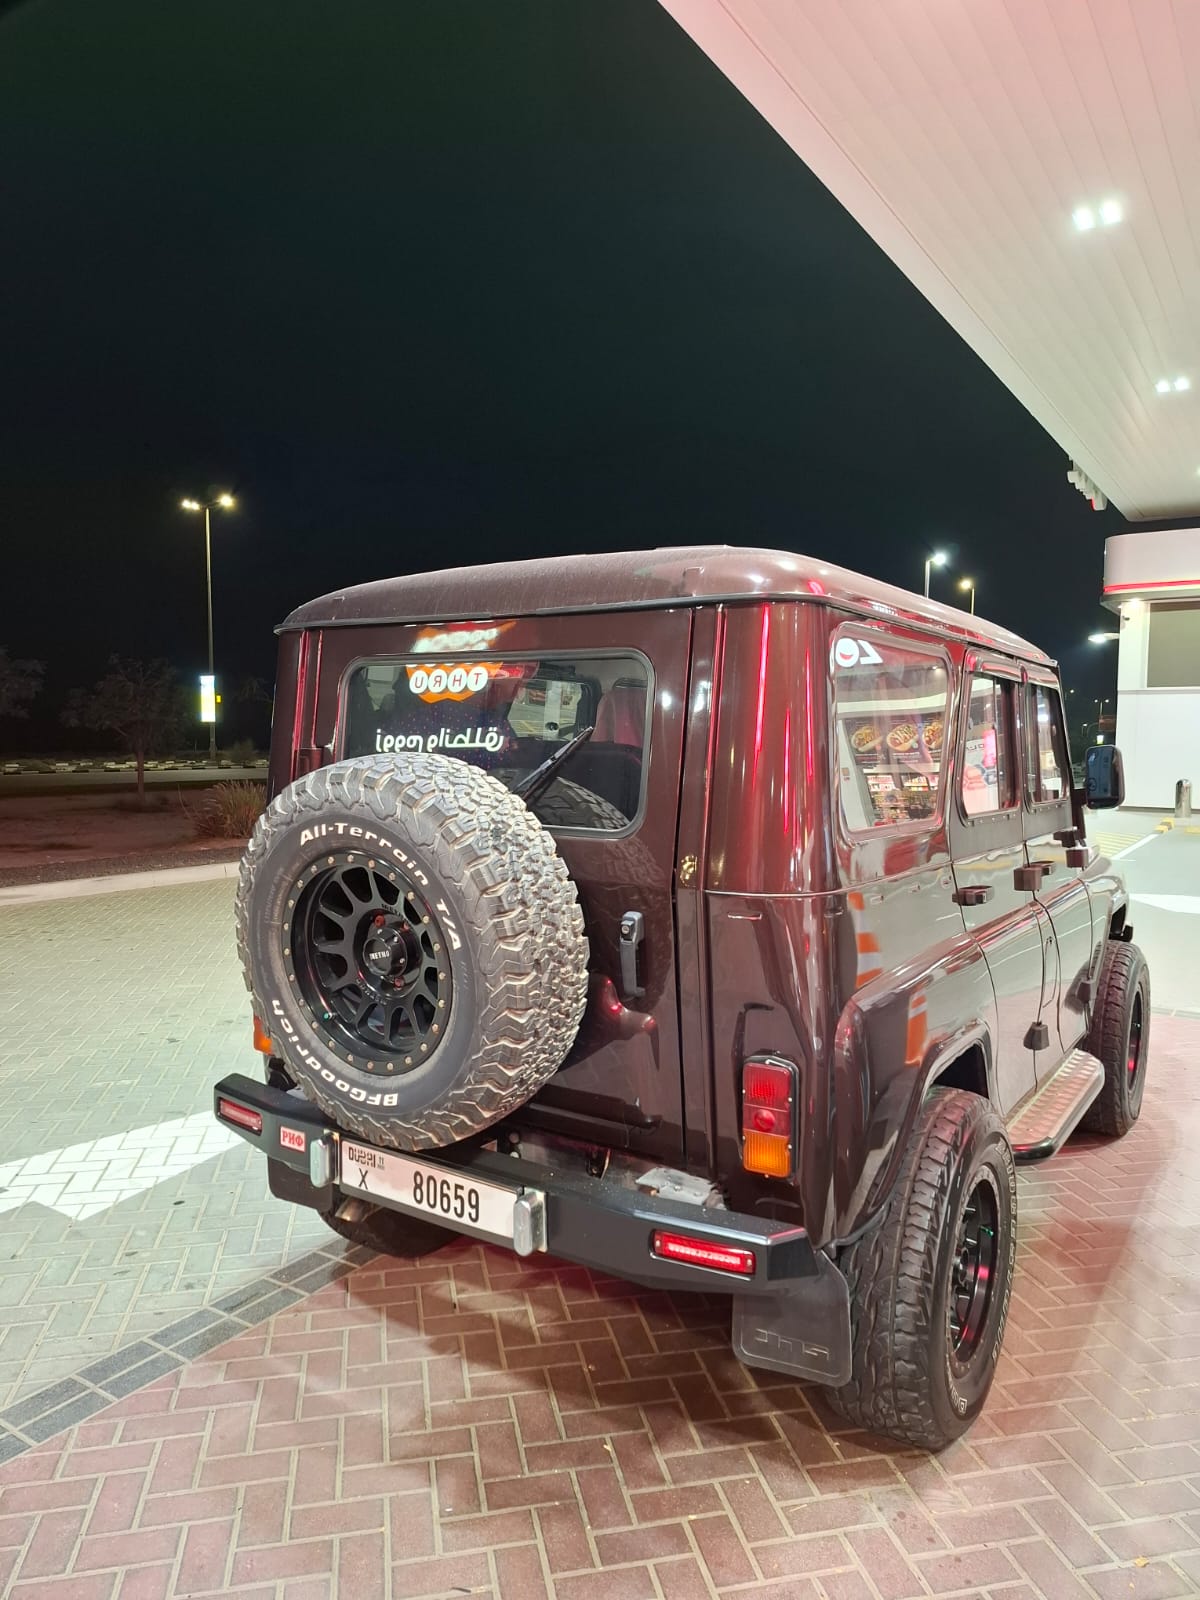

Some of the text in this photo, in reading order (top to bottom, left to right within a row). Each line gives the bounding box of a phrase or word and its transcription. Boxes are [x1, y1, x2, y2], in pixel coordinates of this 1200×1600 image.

[300, 822, 463, 951] All-Terrain T/A
[272, 1000, 398, 1107] BFGoodrich
[282, 1130, 304, 1147] РИФ
[358, 1167, 480, 1223] X 80659
